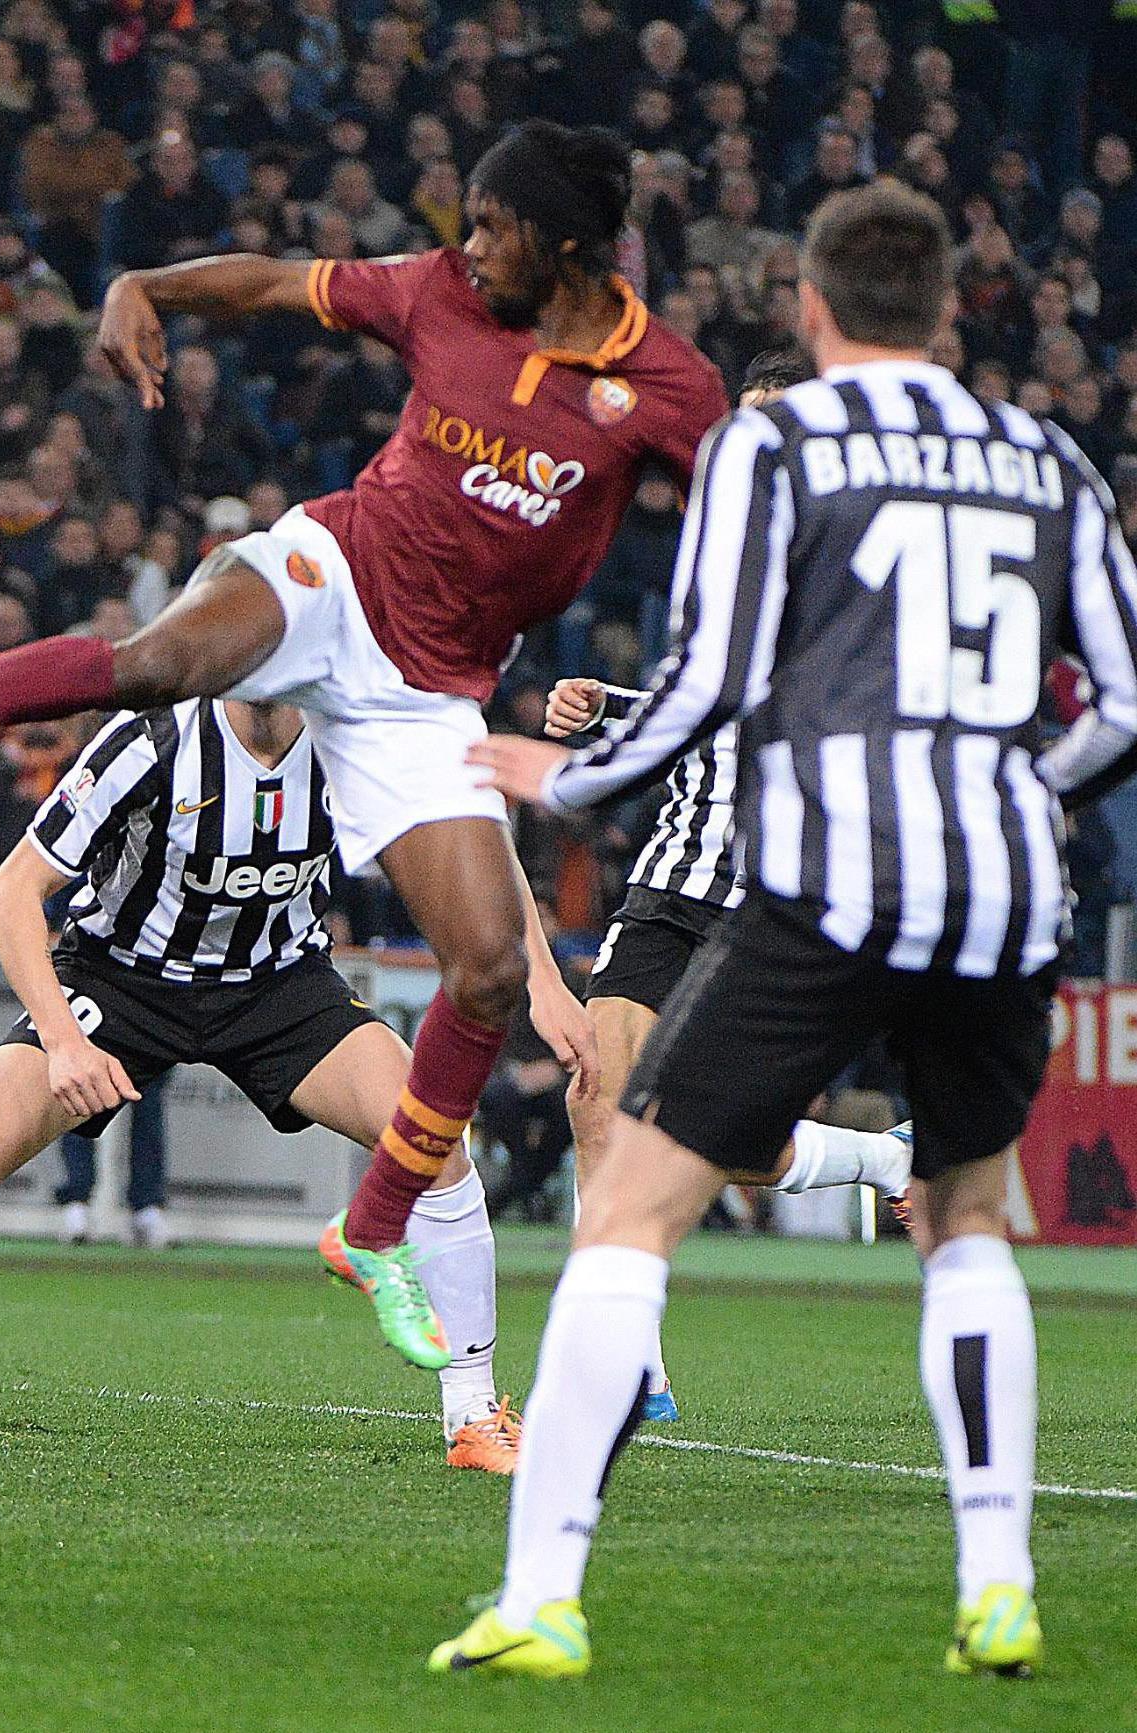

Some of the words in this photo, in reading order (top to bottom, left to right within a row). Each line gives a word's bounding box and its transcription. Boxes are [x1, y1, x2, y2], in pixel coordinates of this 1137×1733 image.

[422, 405, 528, 486] ROMA
[801, 431, 1064, 511] BARZAGLI
[460, 463, 562, 527] Cares
[849, 499, 1041, 729] 15
[183, 853, 331, 899] Jeep
